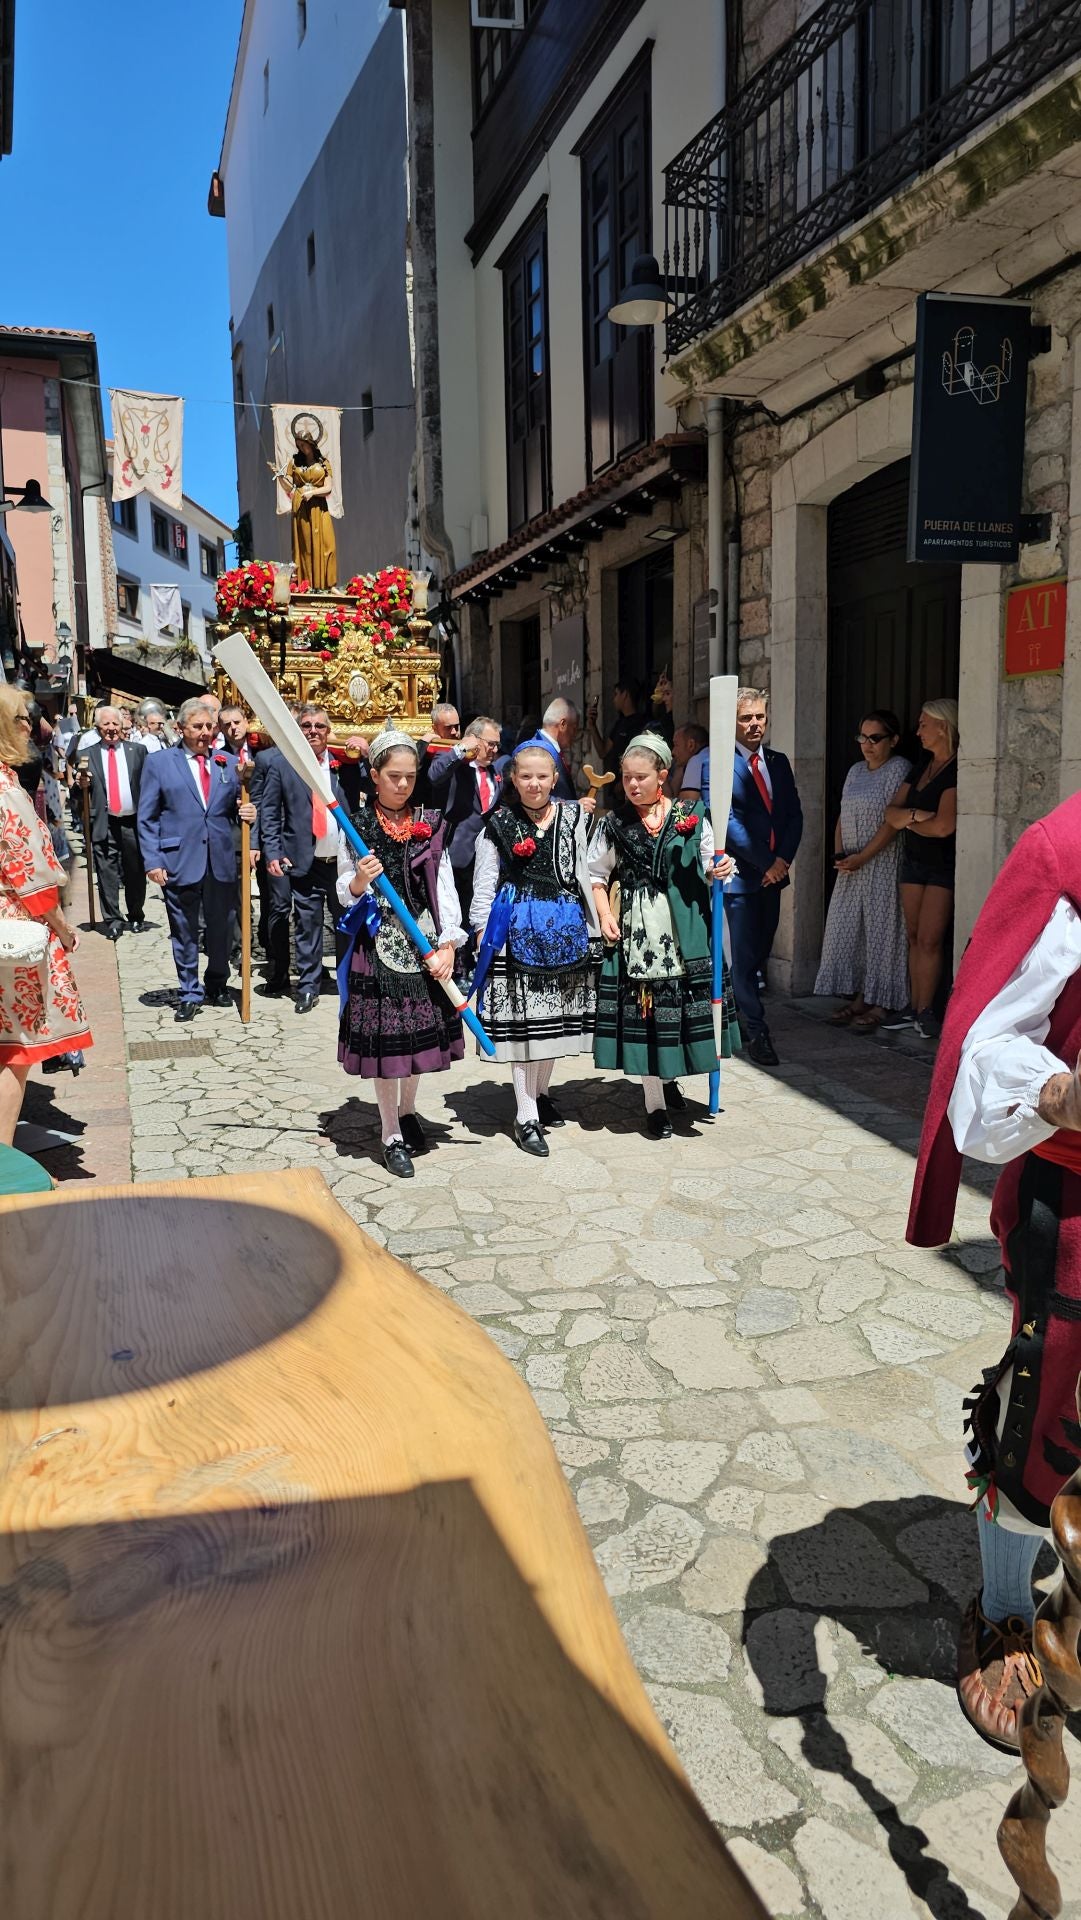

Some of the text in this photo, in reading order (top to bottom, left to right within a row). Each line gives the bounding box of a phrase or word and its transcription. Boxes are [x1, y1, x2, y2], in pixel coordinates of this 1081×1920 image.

[924, 519, 1014, 534] PUERTA DE LLANES
[923, 538, 1012, 548] APARTAMENTOS TURÍSTICOS
[1015, 589, 1058, 634] AT
